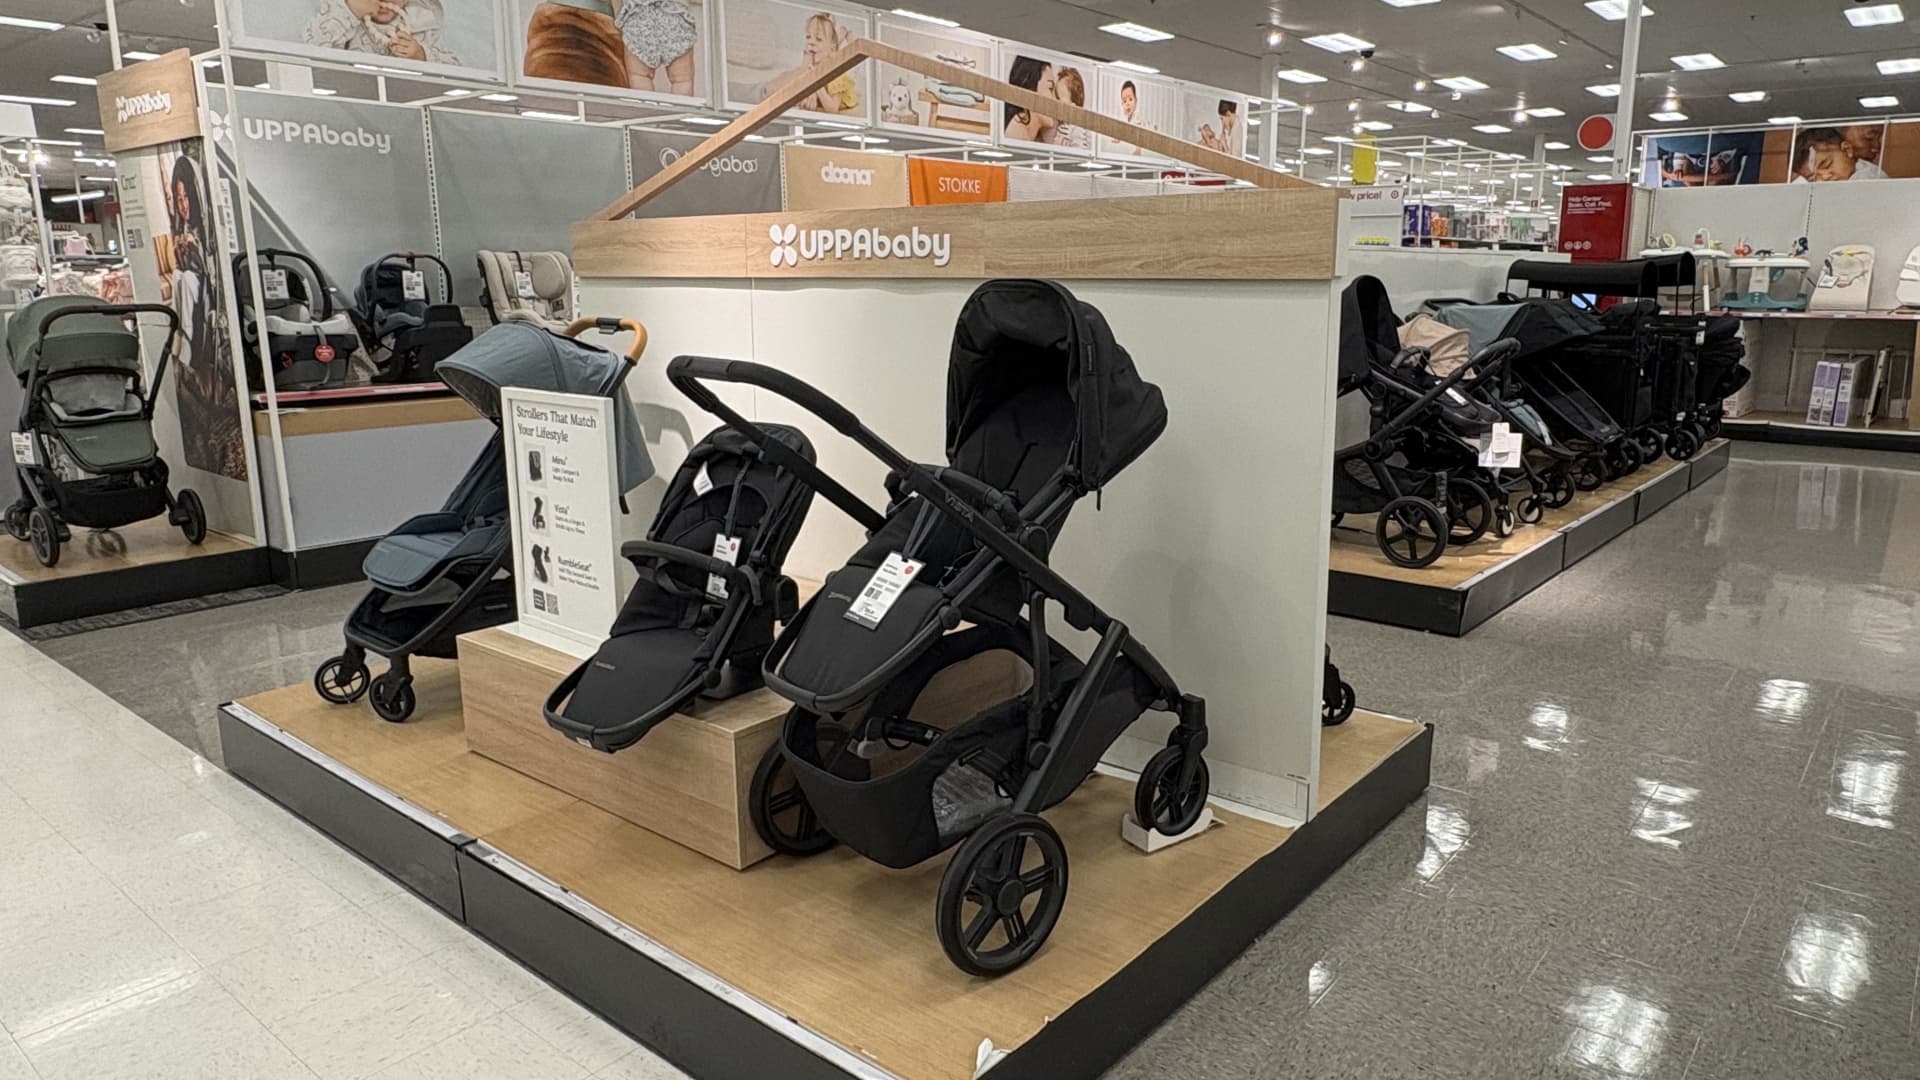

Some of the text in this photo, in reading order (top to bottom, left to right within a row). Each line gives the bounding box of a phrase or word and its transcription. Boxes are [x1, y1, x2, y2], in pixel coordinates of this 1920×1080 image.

[243, 116, 391, 154] UPPAbaby
[820, 161, 872, 187] doona
[938, 176, 981, 195] STOKKE
[800, 226, 950, 267] UPPAbaby
[516, 405, 597, 429] Strollers That Match
[517, 423, 568, 444] Your Lifestyle
